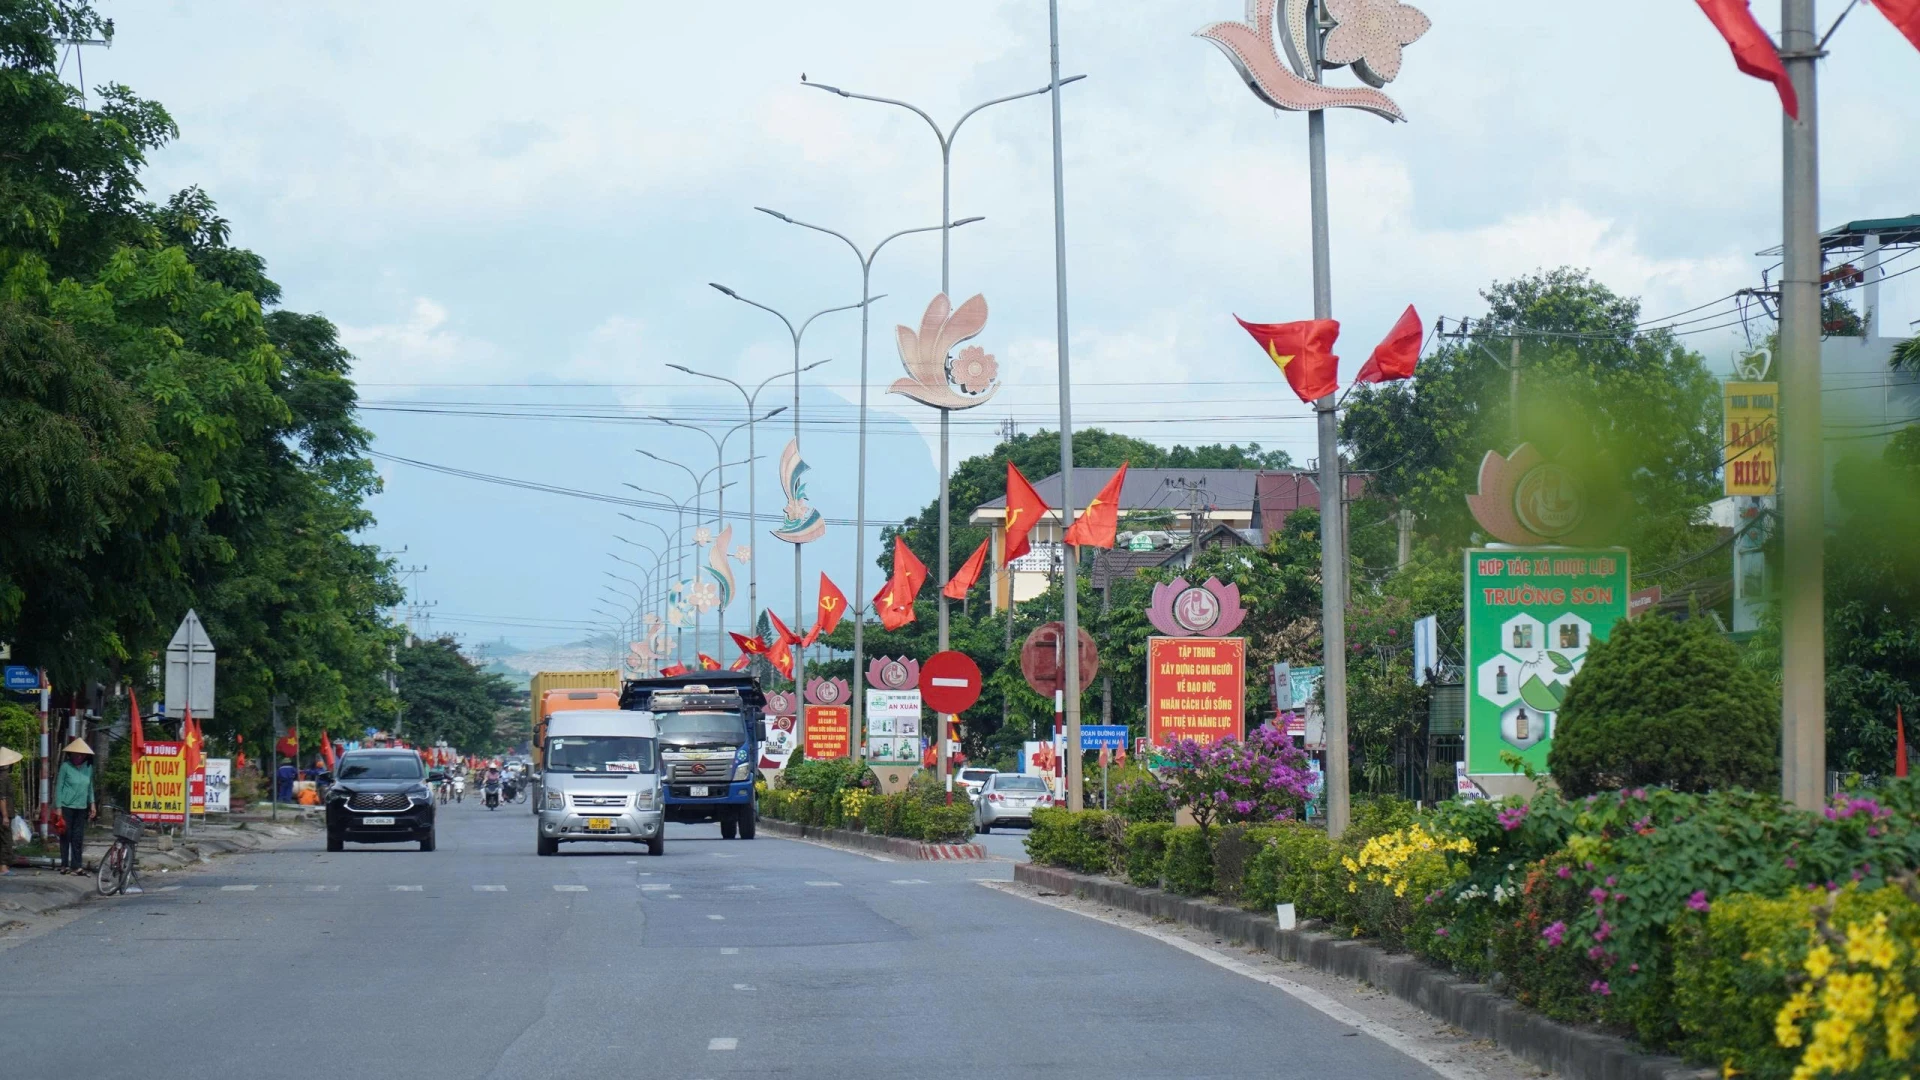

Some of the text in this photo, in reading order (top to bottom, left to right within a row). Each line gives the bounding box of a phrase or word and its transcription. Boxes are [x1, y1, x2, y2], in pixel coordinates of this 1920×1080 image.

[1507, 556, 1530, 576] TÁC
[1533, 556, 1551, 576] XÃ
[1589, 558, 1616, 578] LIỆU
[1484, 583, 1565, 605] TRƯỜNG
[1571, 585, 1613, 604] SƠN
[1178, 646, 1216, 660] TẬP TRUNG
[1160, 662, 1175, 675] XÂY
[1196, 664, 1210, 675] CON
[1160, 697, 1180, 710] NHÂN
[1181, 697, 1200, 710] CÁCH
[1213, 696, 1232, 710] SỐNG
[1187, 714, 1197, 728] VÀ
[1197, 714, 1217, 728] NĂNG
[136, 761, 180, 778] VỊT QUAY
[133, 781, 153, 796] HEO
[156, 781, 182, 797] QUAY
